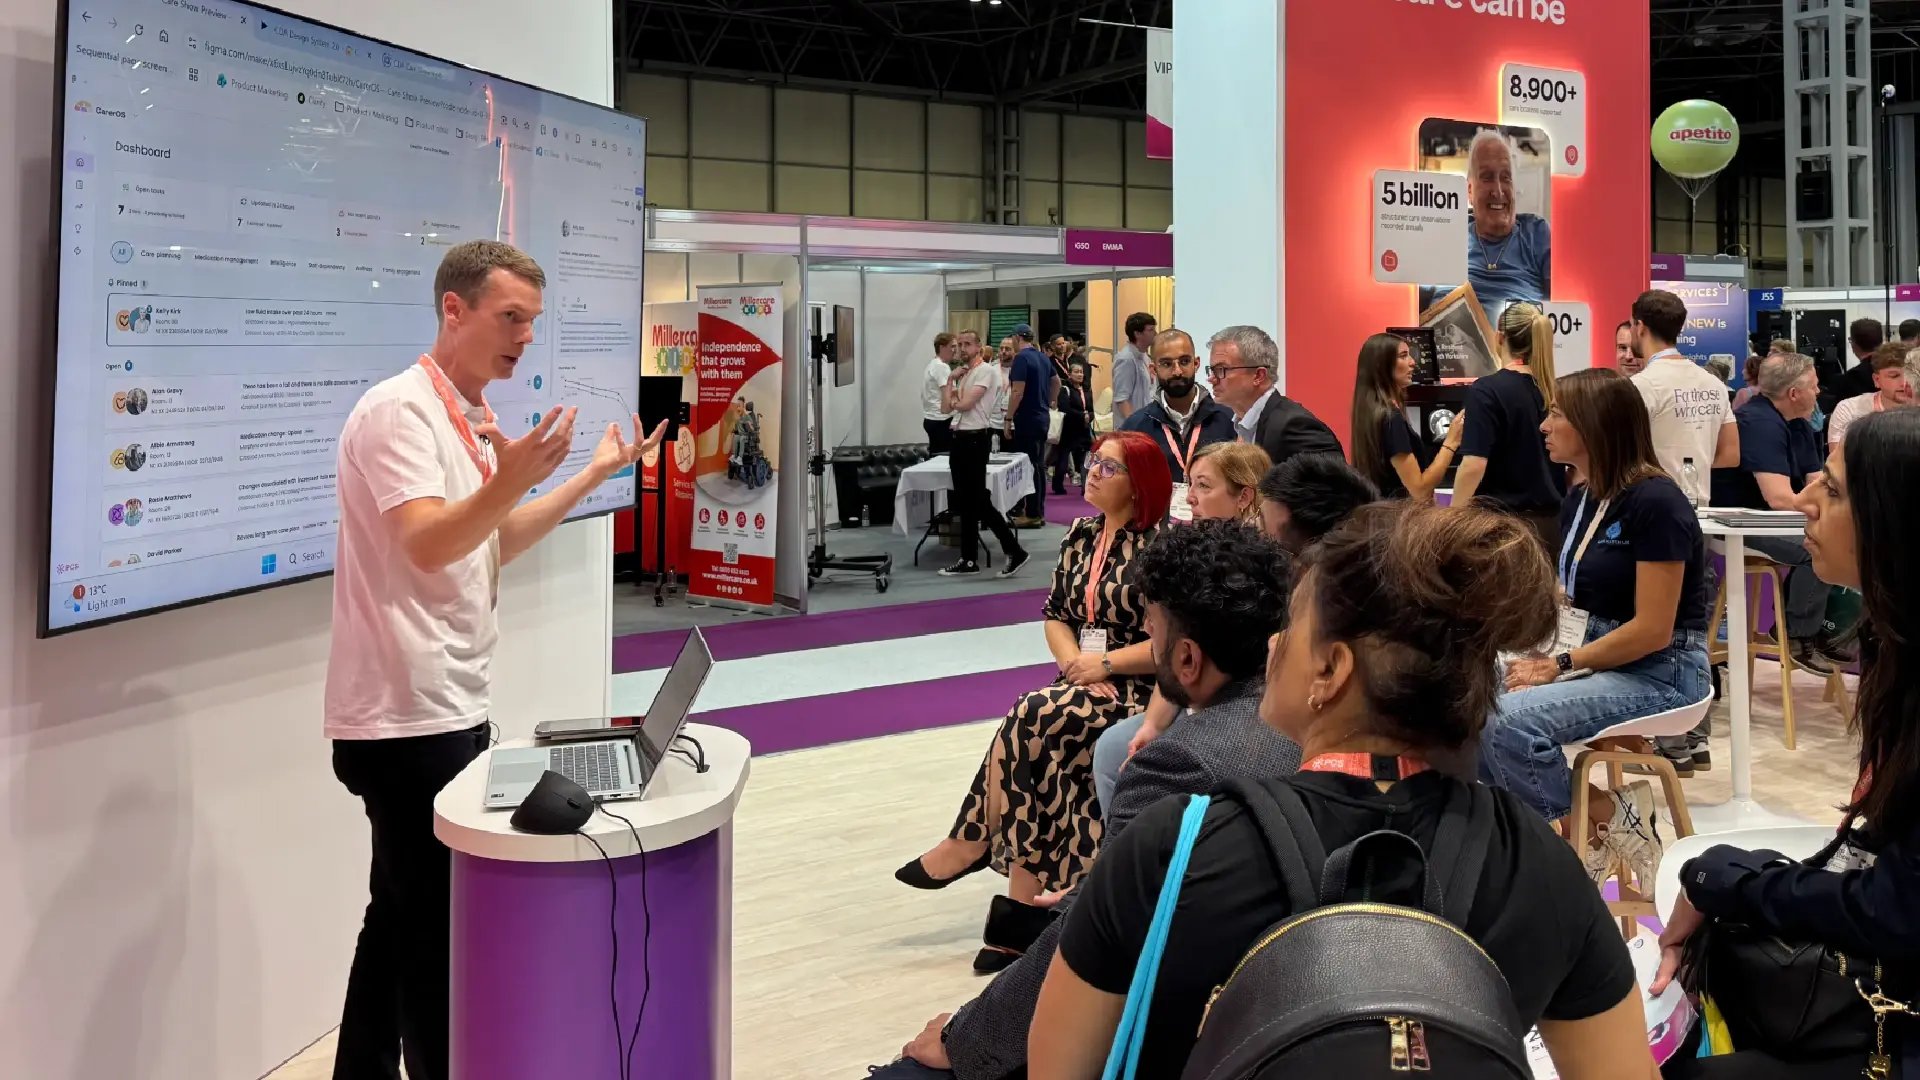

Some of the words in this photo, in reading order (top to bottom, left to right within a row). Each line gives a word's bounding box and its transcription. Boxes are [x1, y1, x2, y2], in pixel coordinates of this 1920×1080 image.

[1530, 0, 1566, 25] be
[1510, 74, 1576, 102] 8,900+
[96, 106, 126, 118] CarerOS
[1670, 128, 1732, 141] apetito
[116, 140, 170, 158] Dashboard
[1382, 182, 1396, 205] 5
[1400, 182, 1458, 210] billion
[1686, 318, 1716, 328] NEW
[1718, 318, 1726, 328] is
[702, 342, 762, 353] Independence
[701, 356, 718, 365] that
[720, 356, 746, 368] grows
[701, 368, 720, 379] with
[721, 368, 742, 379] them
[302, 550, 324, 562] Search
[89, 584, 106, 596] 13°C
[88, 599, 108, 612] Light
